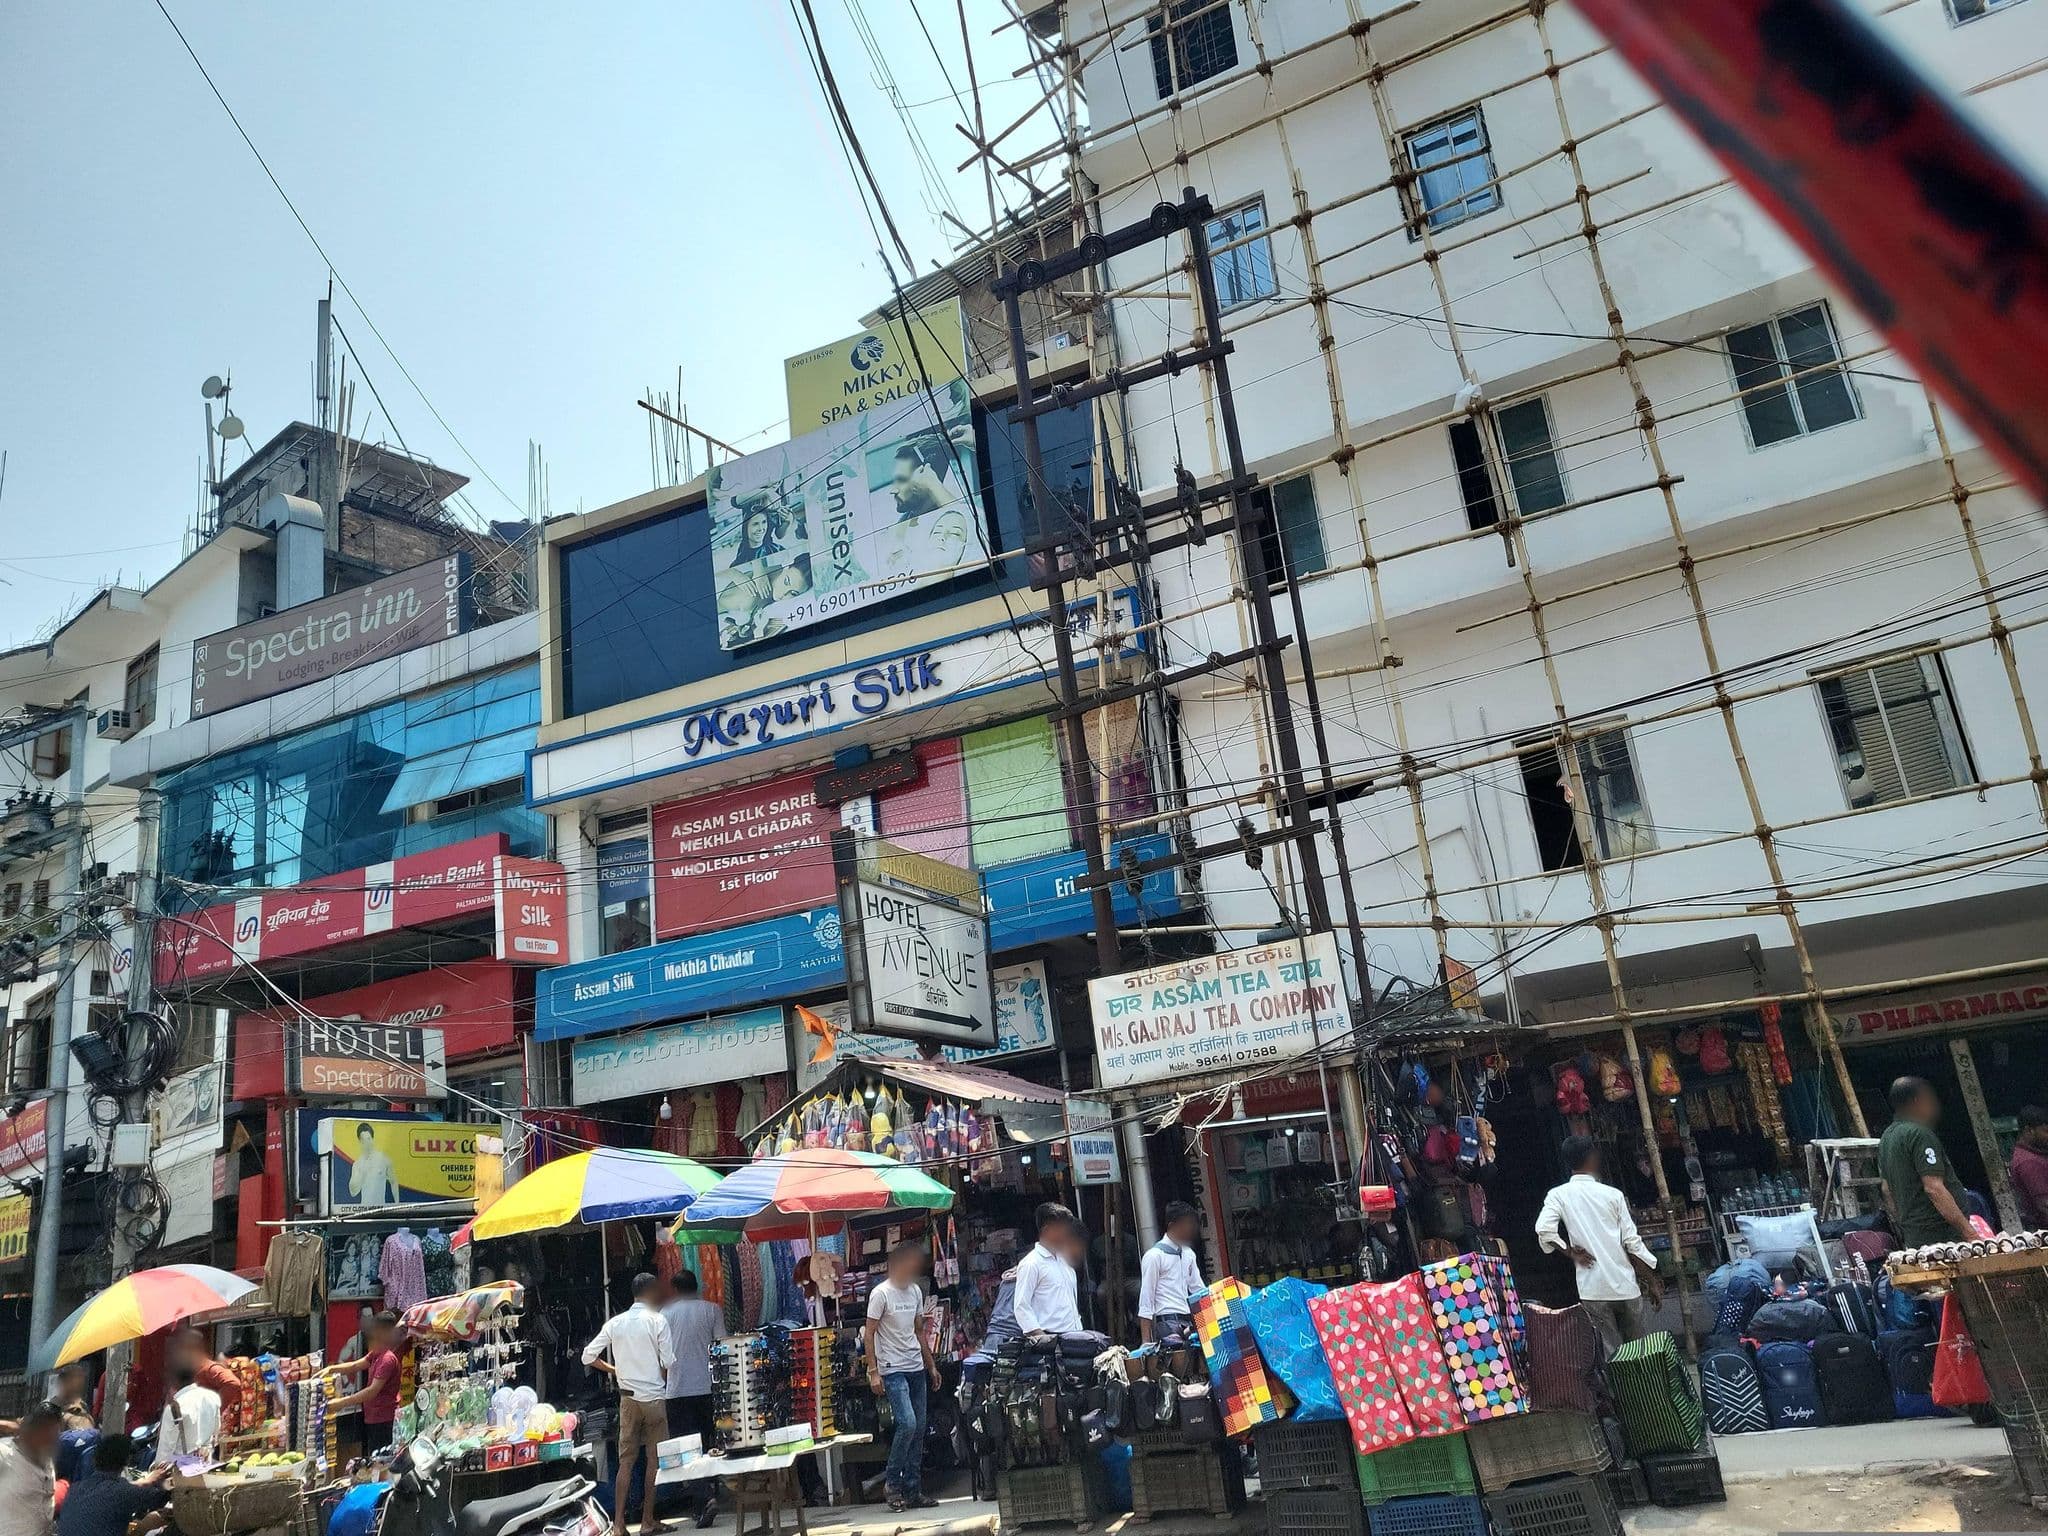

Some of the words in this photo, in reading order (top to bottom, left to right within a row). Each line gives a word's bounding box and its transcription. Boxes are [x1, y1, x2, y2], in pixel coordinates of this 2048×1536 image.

[843, 361, 906, 397] MIKKY
[821, 401, 852, 425] SPA
[857, 397, 870, 413] &
[874, 374, 934, 406] SALON
[826, 470, 854, 581] unisex
[443, 557, 458, 636] HOTEL
[787, 604, 815, 623] +91
[820, 569, 919, 614] 6901116596
[225, 610, 352, 681] Spectra
[360, 586, 422, 634] inn
[278, 658, 325, 682] Lodging
[331, 638, 388, 667] Breakfast
[683, 680, 836, 757] Mayuri
[851, 652, 943, 715] Silk
[671, 815, 725, 838] ASSAM
[729, 803, 766, 824] SILK
[679, 827, 743, 854] MEKHLA
[748, 812, 813, 839] CHADAR
[671, 854, 755, 880] WHOLESALE
[759, 847, 770, 859] &
[774, 835, 825, 857] RETAIL
[399, 871, 445, 895] Union
[446, 860, 486, 882] Bank
[506, 871, 561, 896] Mayuri
[719, 876, 741, 893] 1st
[744, 870, 779, 888] Floor
[1055, 875, 1076, 898] Eri
[266, 906, 309, 931] यूनियन
[456, 898, 477, 908] PALTAN
[521, 905, 552, 927] Silk
[866, 892, 927, 930] HOTEL
[526, 940, 534, 950] 1st
[535, 940, 549, 950] Floor
[664, 961, 707, 981] Mekhla
[710, 949, 755, 972] Chadar
[800, 955, 841, 969] MAYURI
[883, 931, 978, 996] AVENUE
[1278, 958, 1322, 983] चाय
[612, 971, 635, 993] Silk
[1151, 977, 1223, 1011] ASSAM
[1227, 970, 1270, 995] TEA
[388, 1004, 444, 1026] WORLD
[885, 1003, 898, 1013] FIRST
[899, 1007, 915, 1016] FLOOR
[1128, 1011, 1197, 1044] GAJRAJ
[1204, 1003, 1241, 1031] TEA
[1250, 983, 1337, 1022] COMPANY
[1858, 985, 2048, 1035] PHARMAC
[310, 1023, 420, 1059] HOTEL
[575, 1050, 623, 1075] CITY
[629, 1036, 700, 1064] CLOTH
[708, 1022, 785, 1052] HOUSE
[1237, 1045, 1277, 1061] 07588
[1128, 1048, 1162, 1068] आसाम
[313, 1065, 384, 1090] Spectra
[388, 1066, 418, 1090] inn
[414, 1139, 457, 1153] LUX
[1926, 1147, 1937, 1165] 3
[440, 1165, 469, 1173] CHEHRE
[447, 1173, 476, 1183] MUSKA
